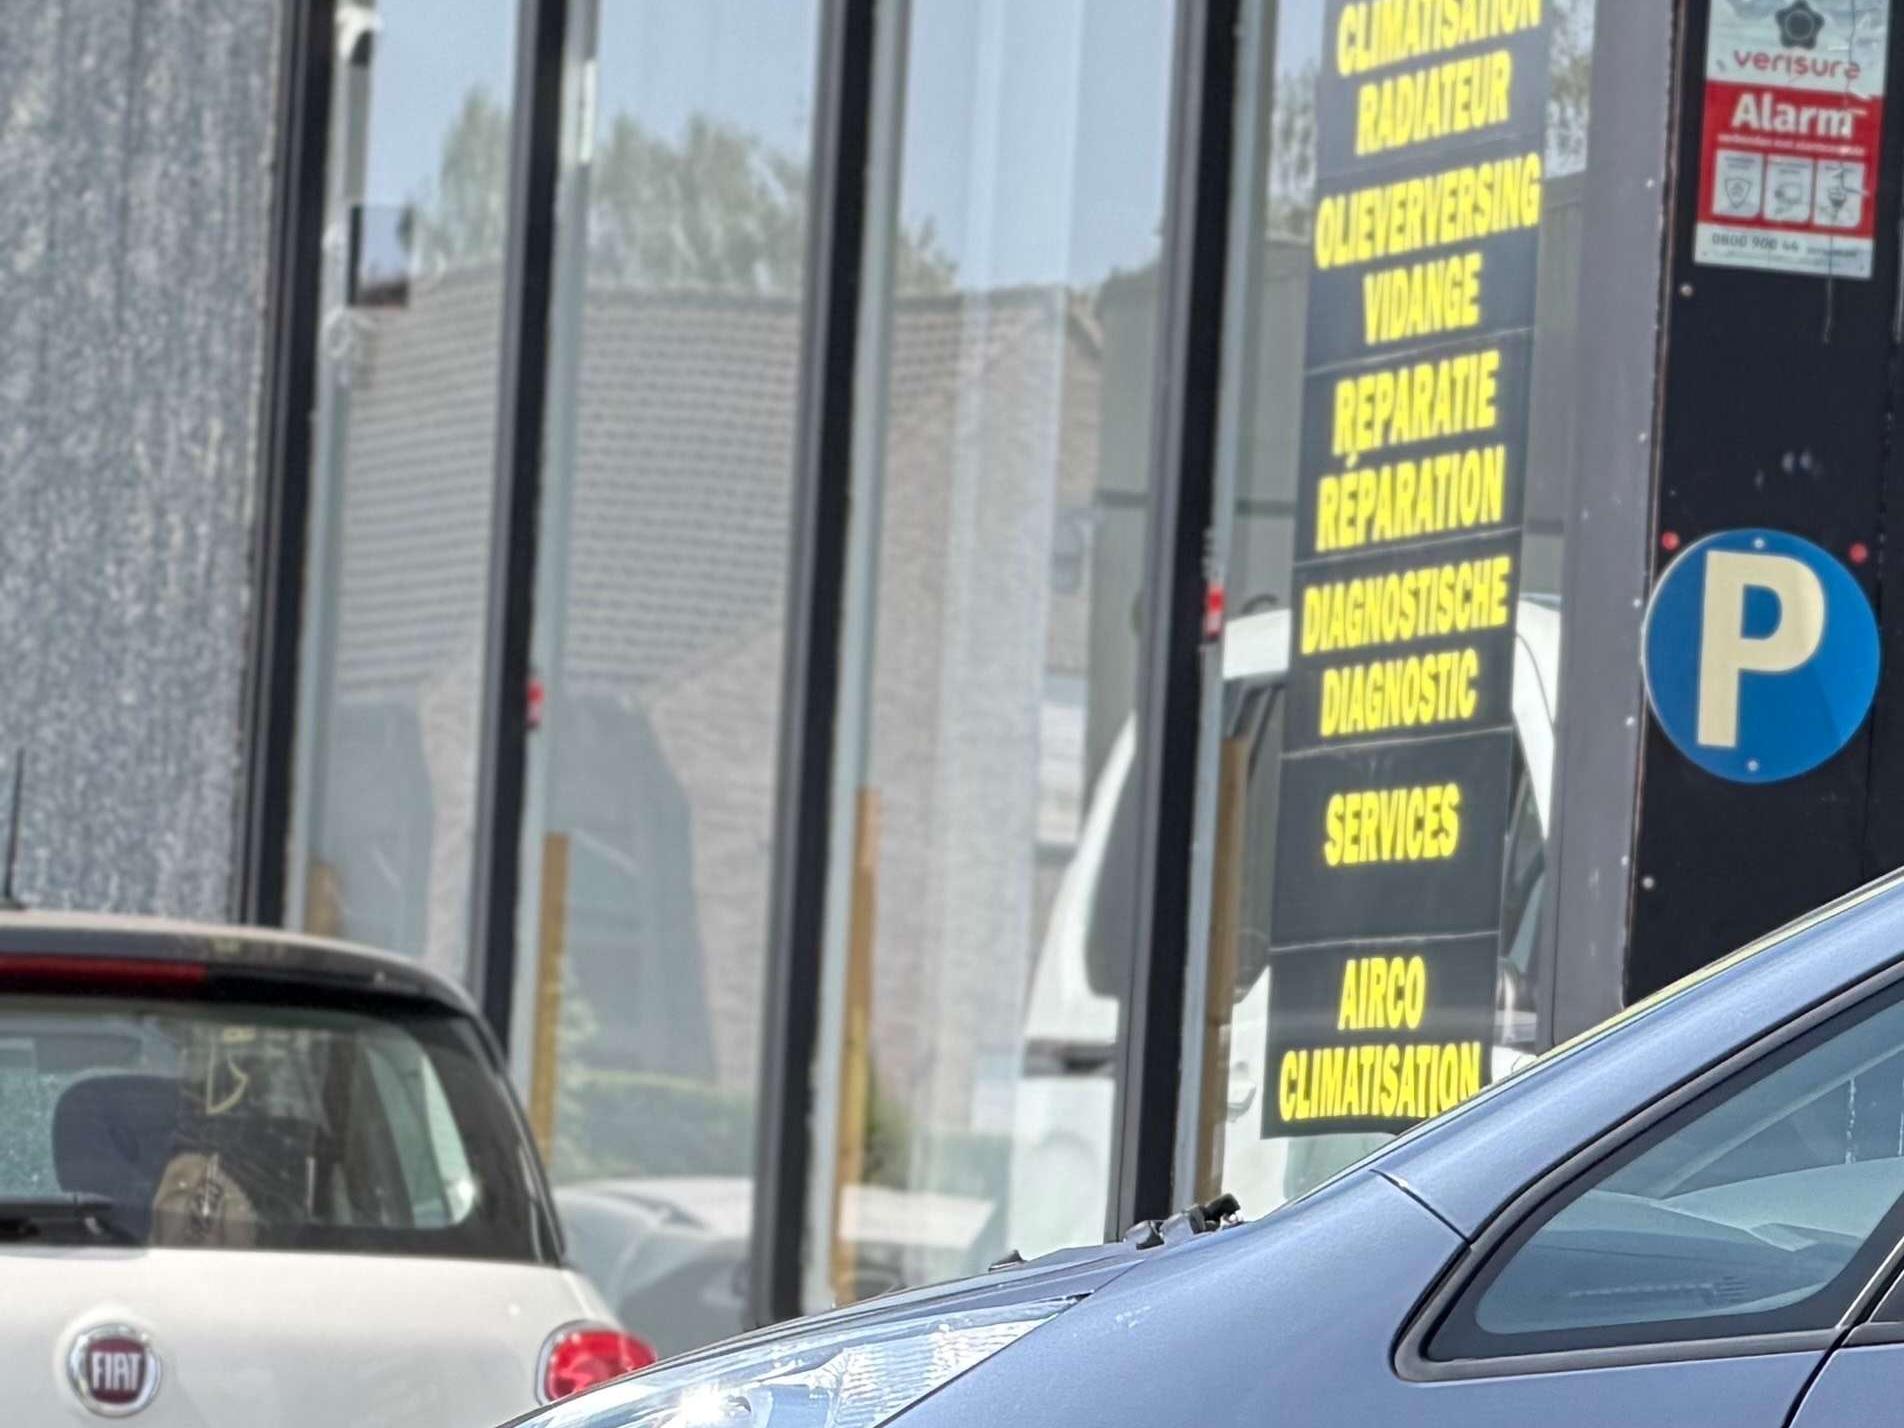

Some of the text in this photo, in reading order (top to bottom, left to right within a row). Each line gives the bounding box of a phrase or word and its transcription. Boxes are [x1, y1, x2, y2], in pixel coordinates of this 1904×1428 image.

[1356, 50, 1513, 155] RADIATEUR
[1731, 92, 1854, 140] Alarm
[1315, 153, 1543, 269] OLIEVERVERSING
[1364, 252, 1483, 344] VIDANGE
[1332, 351, 1501, 457] REPARATIE
[1315, 445, 1507, 552] RÉPARATION
[1301, 556, 1512, 656] DIAGNOSTISCHE
[1696, 550, 1826, 749] P
[1319, 648, 1479, 739] DIAGNOSTIC
[1322, 782, 1462, 868] SERVICES
[1337, 955, 1427, 1031] AIRCO
[1278, 1042, 1482, 1124] CLIMATISATION
[91, 1351, 142, 1392] FIAT
